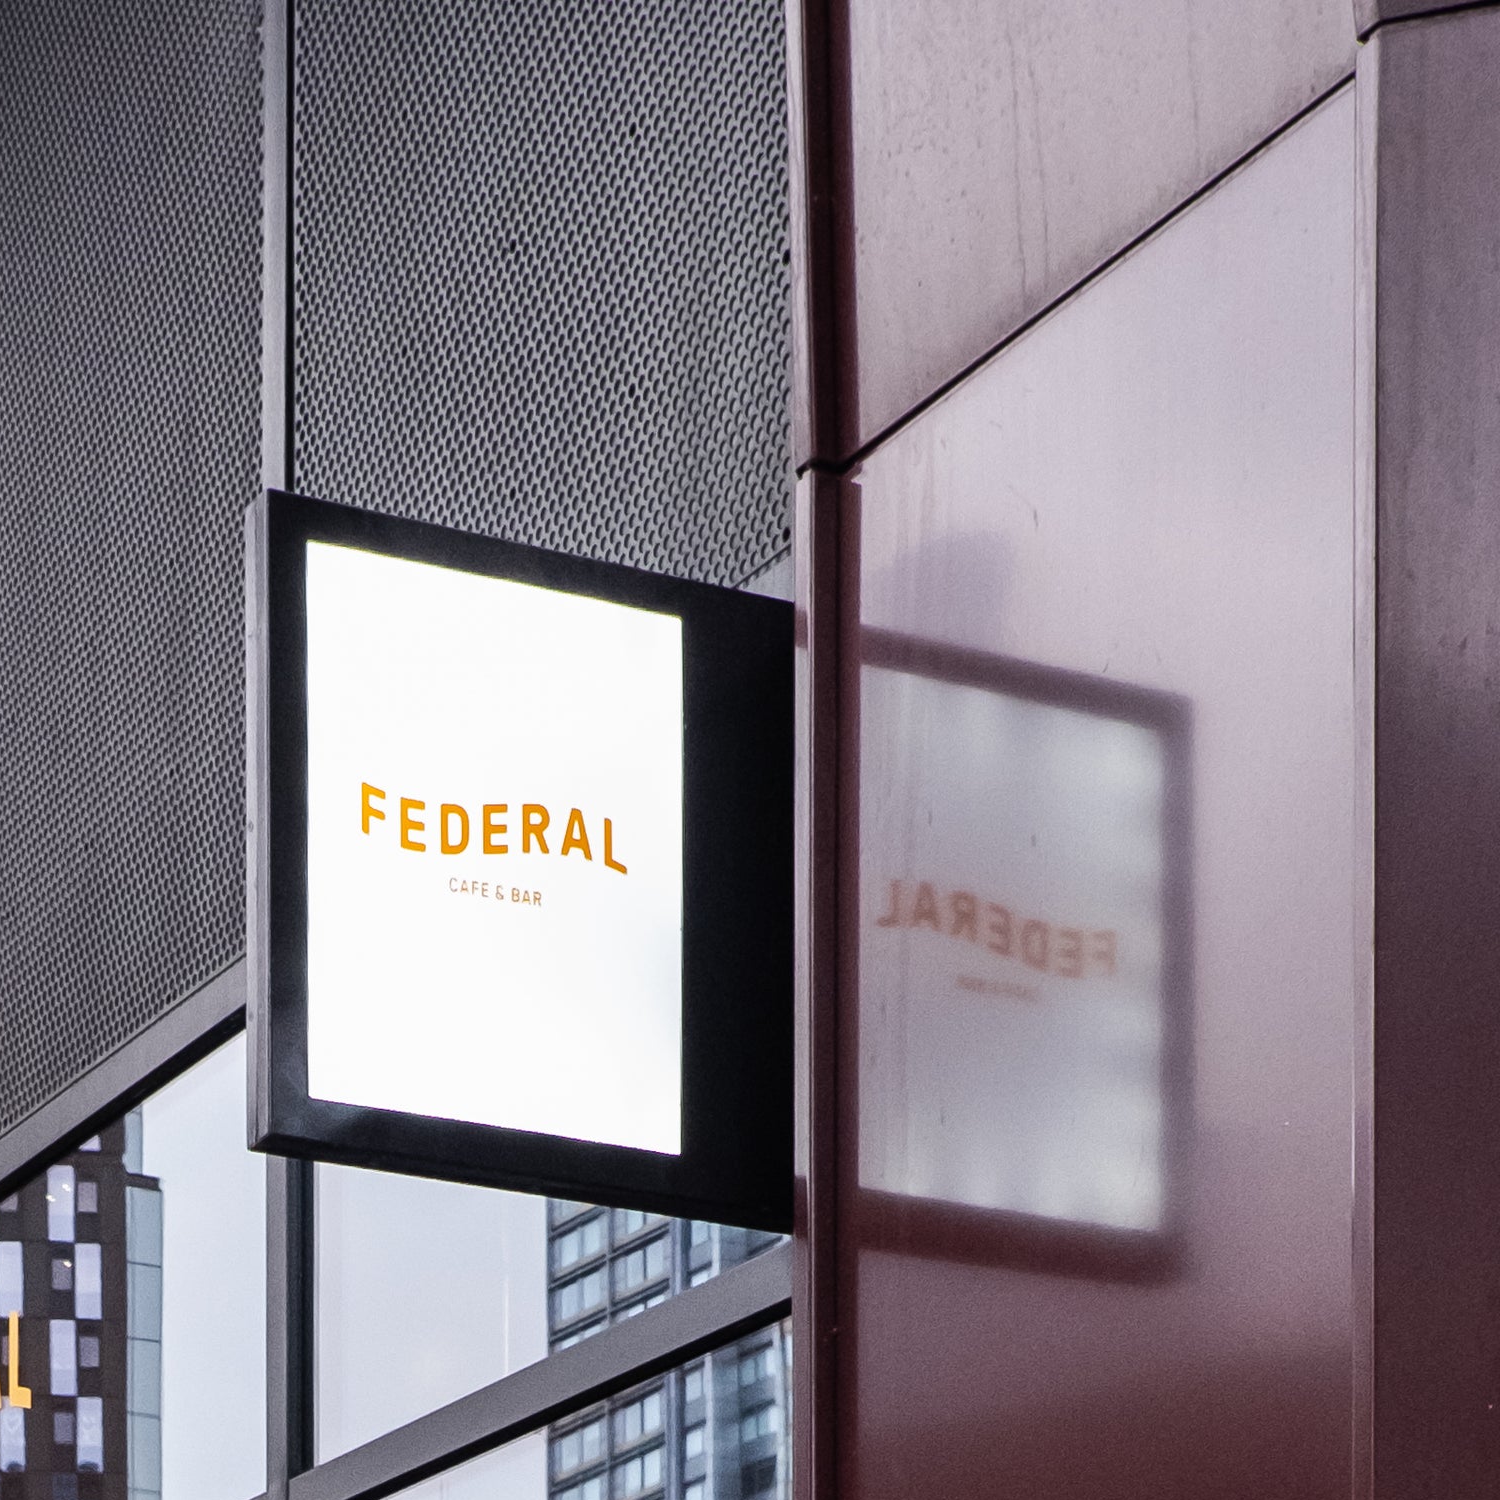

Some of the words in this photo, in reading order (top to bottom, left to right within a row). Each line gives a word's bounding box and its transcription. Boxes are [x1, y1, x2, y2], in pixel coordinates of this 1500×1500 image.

[361, 781, 628, 876] FEDERAL
[449, 878, 489, 897] CAFE
[495, 885, 504, 900] &
[511, 888, 542, 907] BAR
